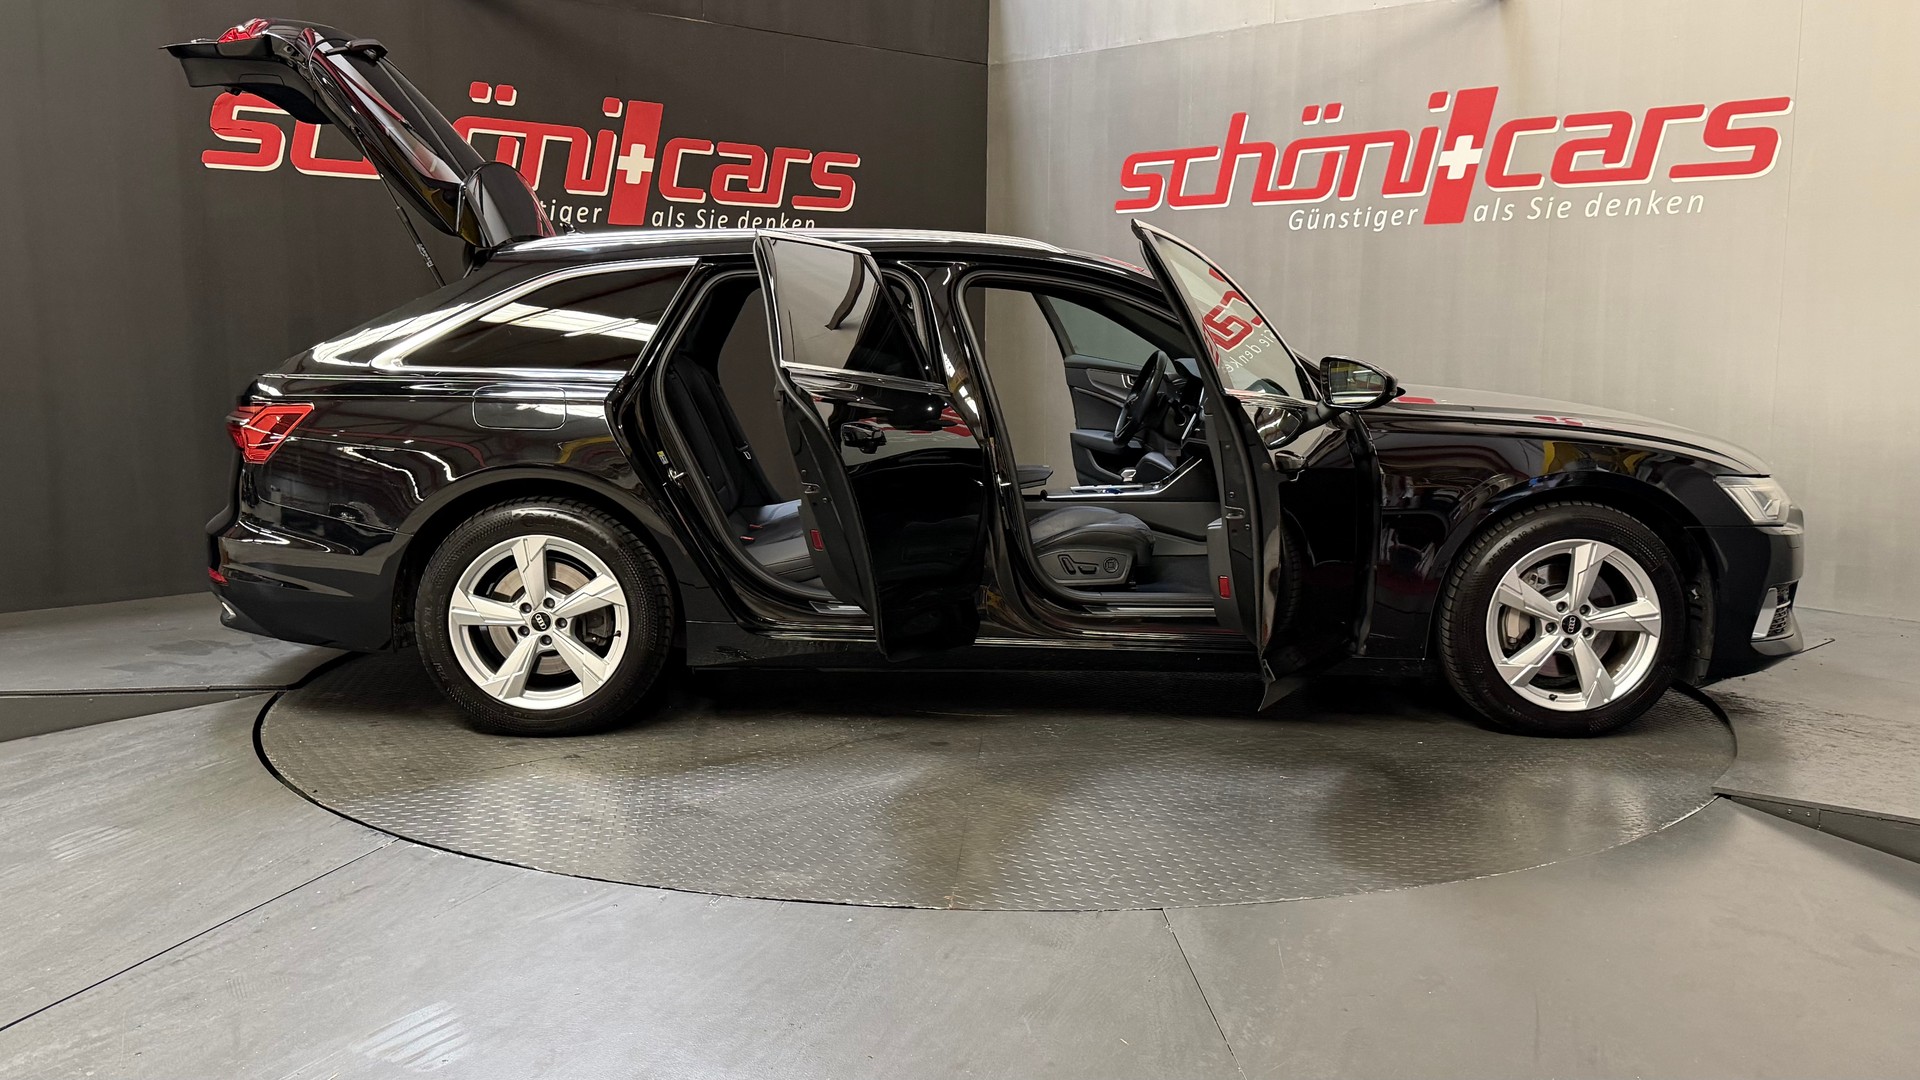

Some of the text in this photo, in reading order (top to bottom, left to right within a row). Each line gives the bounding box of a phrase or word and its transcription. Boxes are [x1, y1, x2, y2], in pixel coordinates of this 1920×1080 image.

[1484, 96, 1793, 192] cars
[659, 137, 860, 212] cars
[651, 205, 685, 228] als
[695, 208, 729, 228] Sie
[737, 210, 816, 228] denken
[1288, 189, 1705, 232] Günstiger als Sie denken
